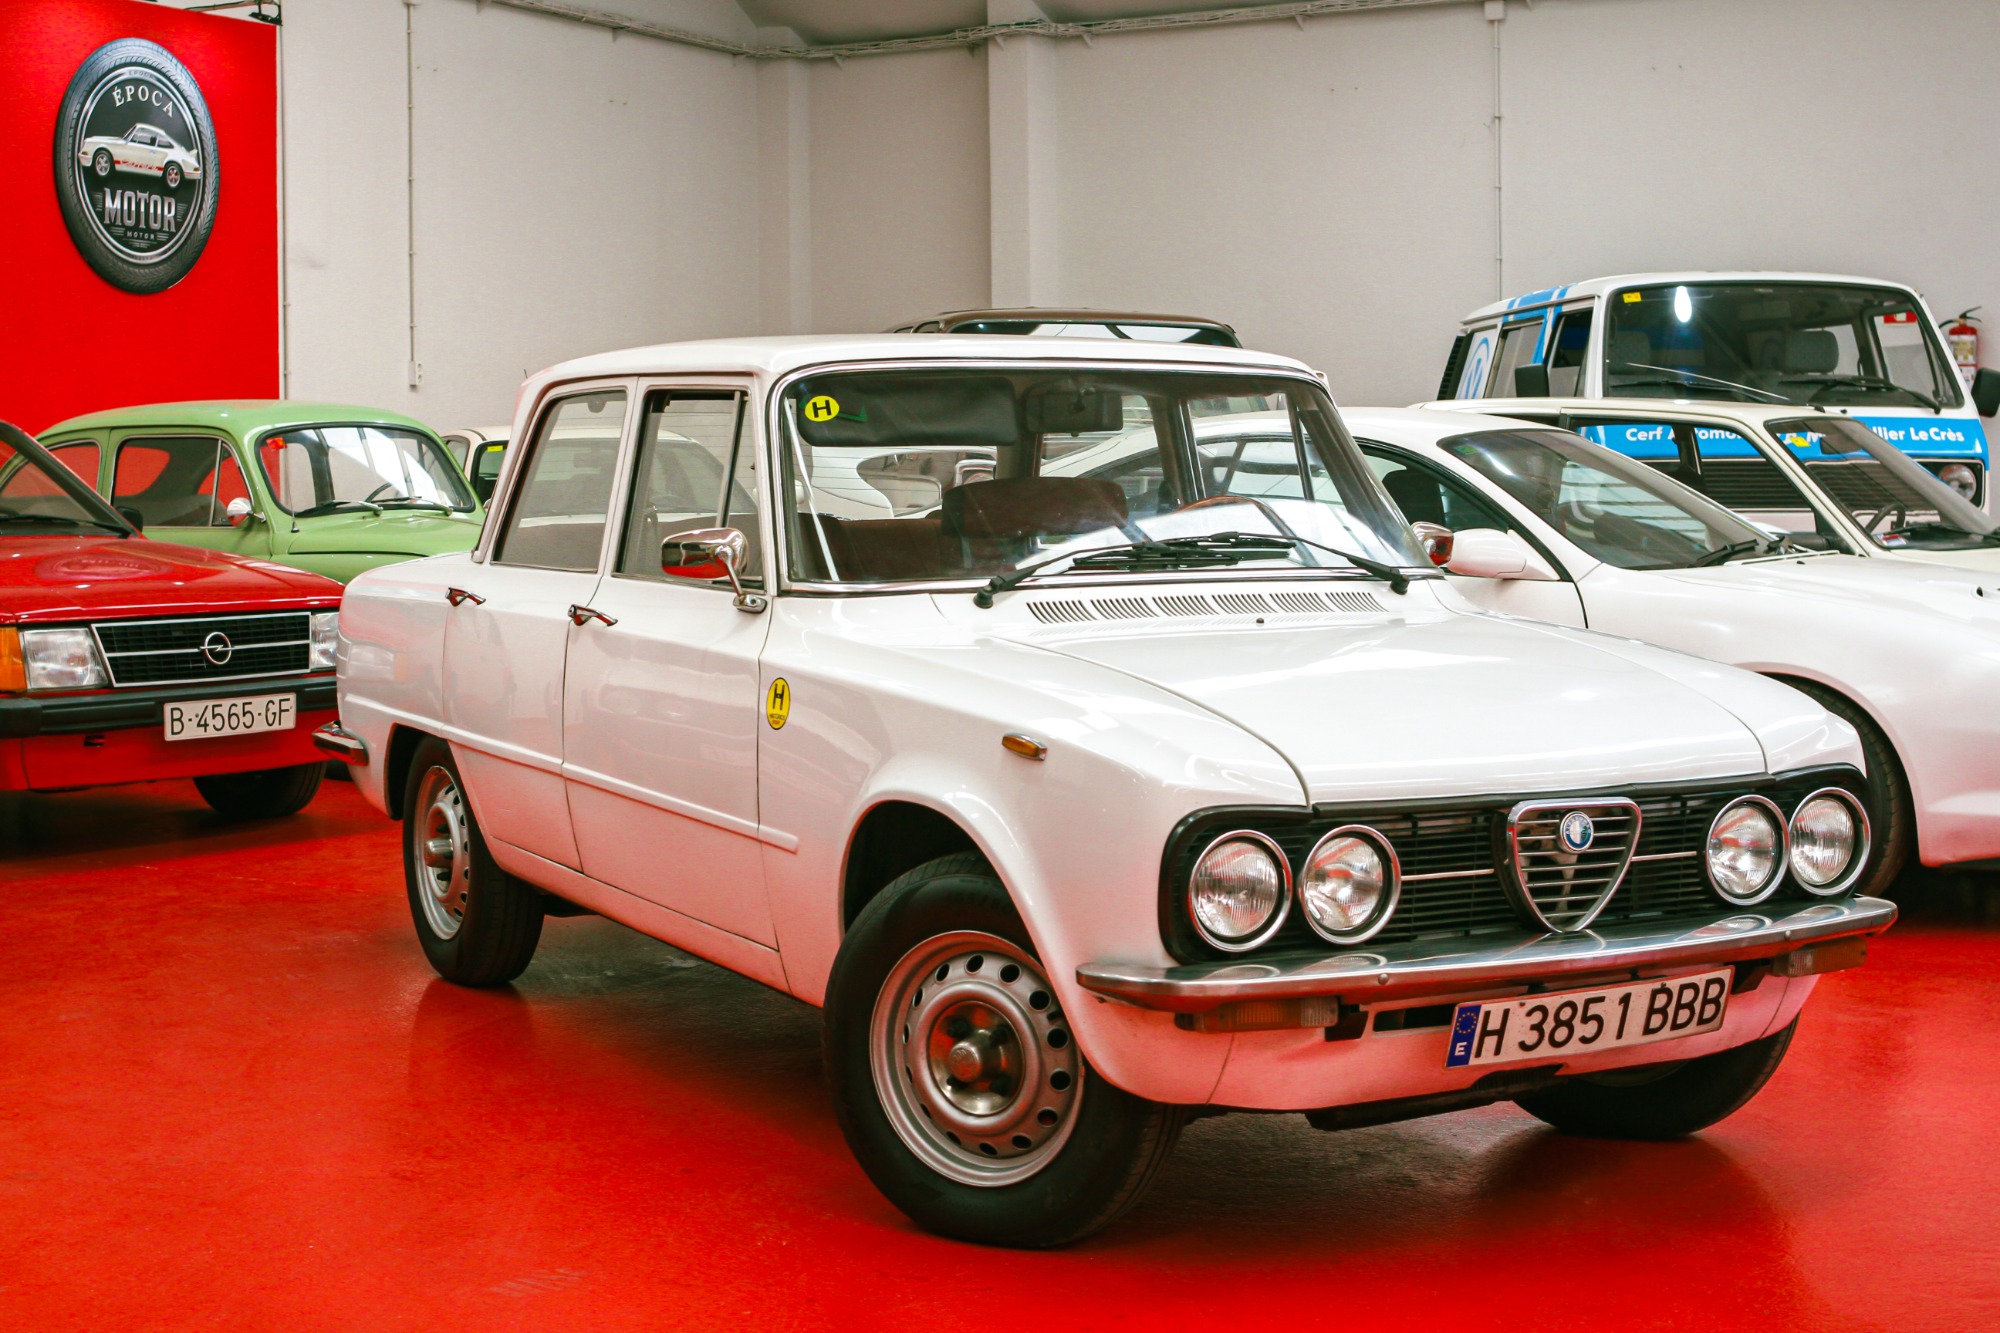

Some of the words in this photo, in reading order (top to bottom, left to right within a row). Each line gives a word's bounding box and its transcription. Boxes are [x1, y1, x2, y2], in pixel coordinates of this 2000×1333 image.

[112, 85, 173, 118] ÉPOCA
[104, 187, 176, 232] MOTOR
[126, 231, 155, 240] MOTOR
[812, 400, 832, 418] H
[1626, 426, 1663, 441] Cerf
[773, 683, 785, 711] H
[1474, 1008, 1511, 1059] H
[1518, 992, 1632, 1051] 3851
[1641, 977, 1726, 1036] BBB
[1454, 1041, 1468, 1056] E
